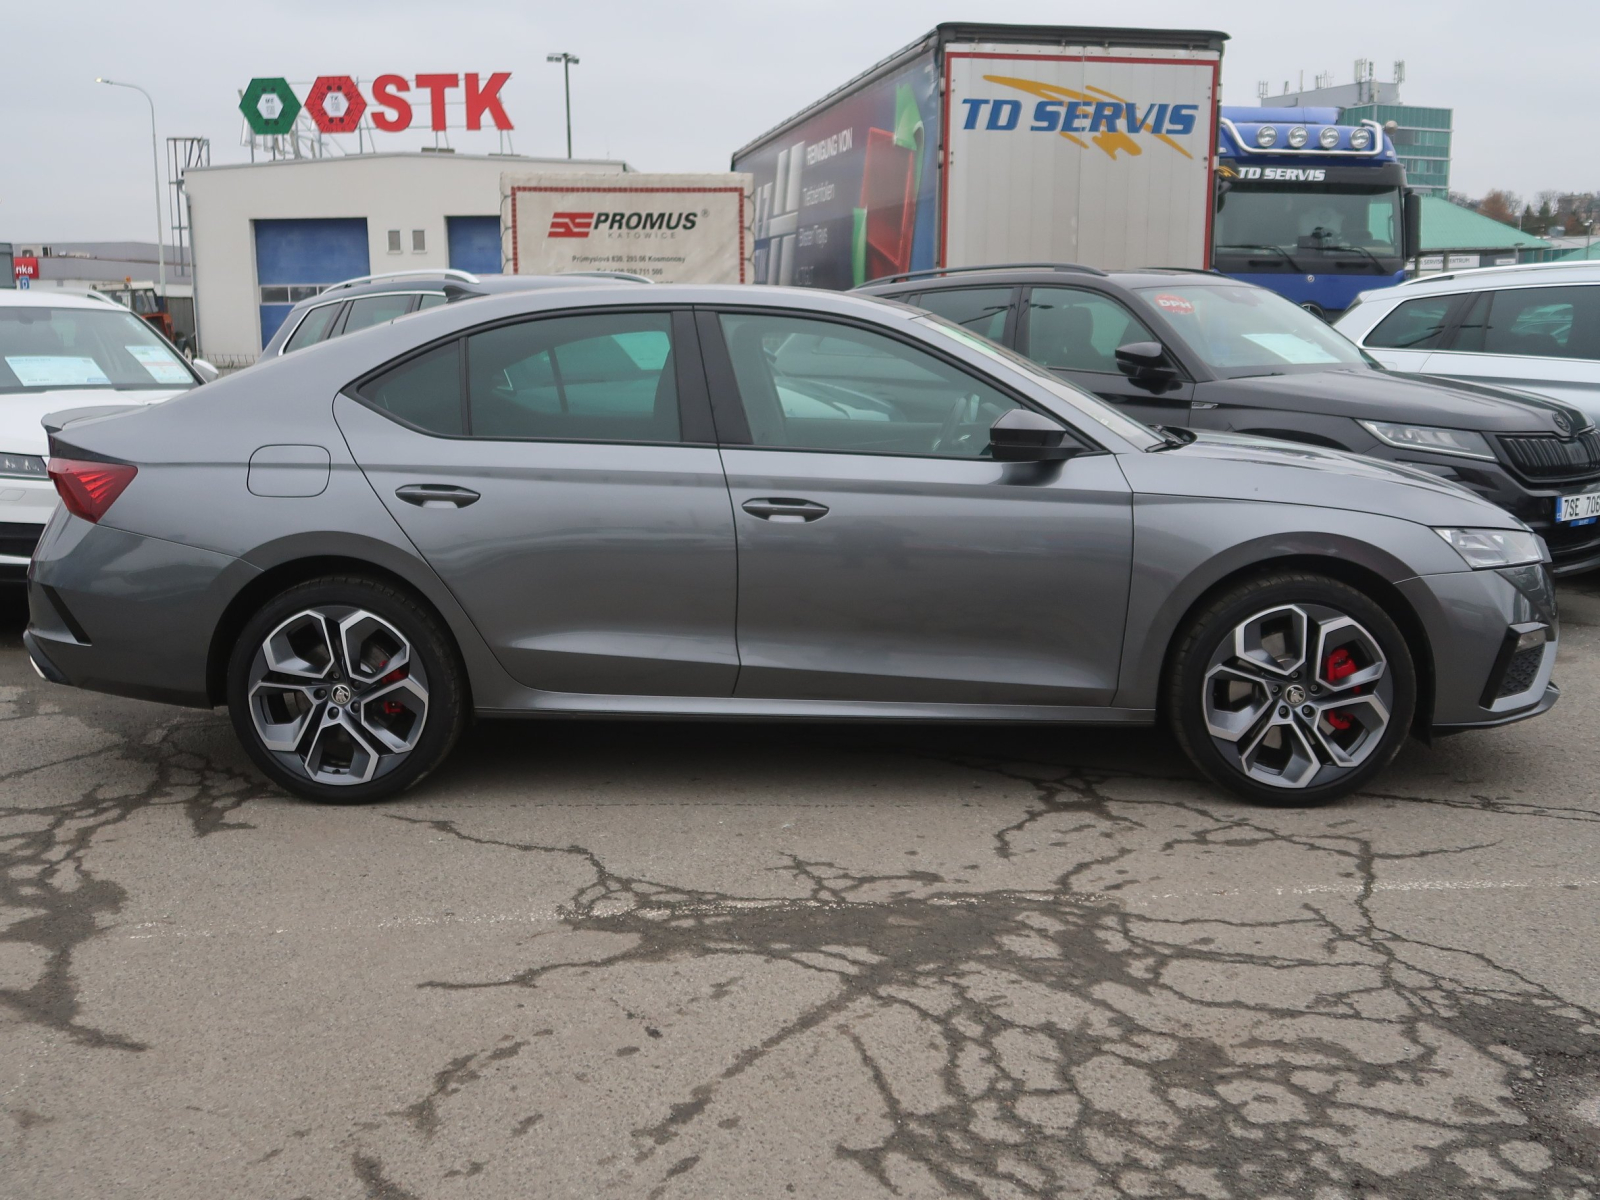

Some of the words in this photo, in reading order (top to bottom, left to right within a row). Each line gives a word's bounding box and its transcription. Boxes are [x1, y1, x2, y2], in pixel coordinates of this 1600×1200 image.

[371, 72, 514, 133] STK
[962, 98, 1023, 131] TD
[1030, 100, 1200, 136] SERVIS
[838, 127, 853, 153] VON
[1238, 166, 1262, 179] TD
[1264, 167, 1326, 182] SERVIS
[593, 212, 698, 230] PROMUS
[608, 231, 677, 240] KATOWICE
[1424, 258, 1443, 266] SERVISN
[1158, 299, 1192, 309] DPH
[1564, 497, 1581, 519] 7SE
